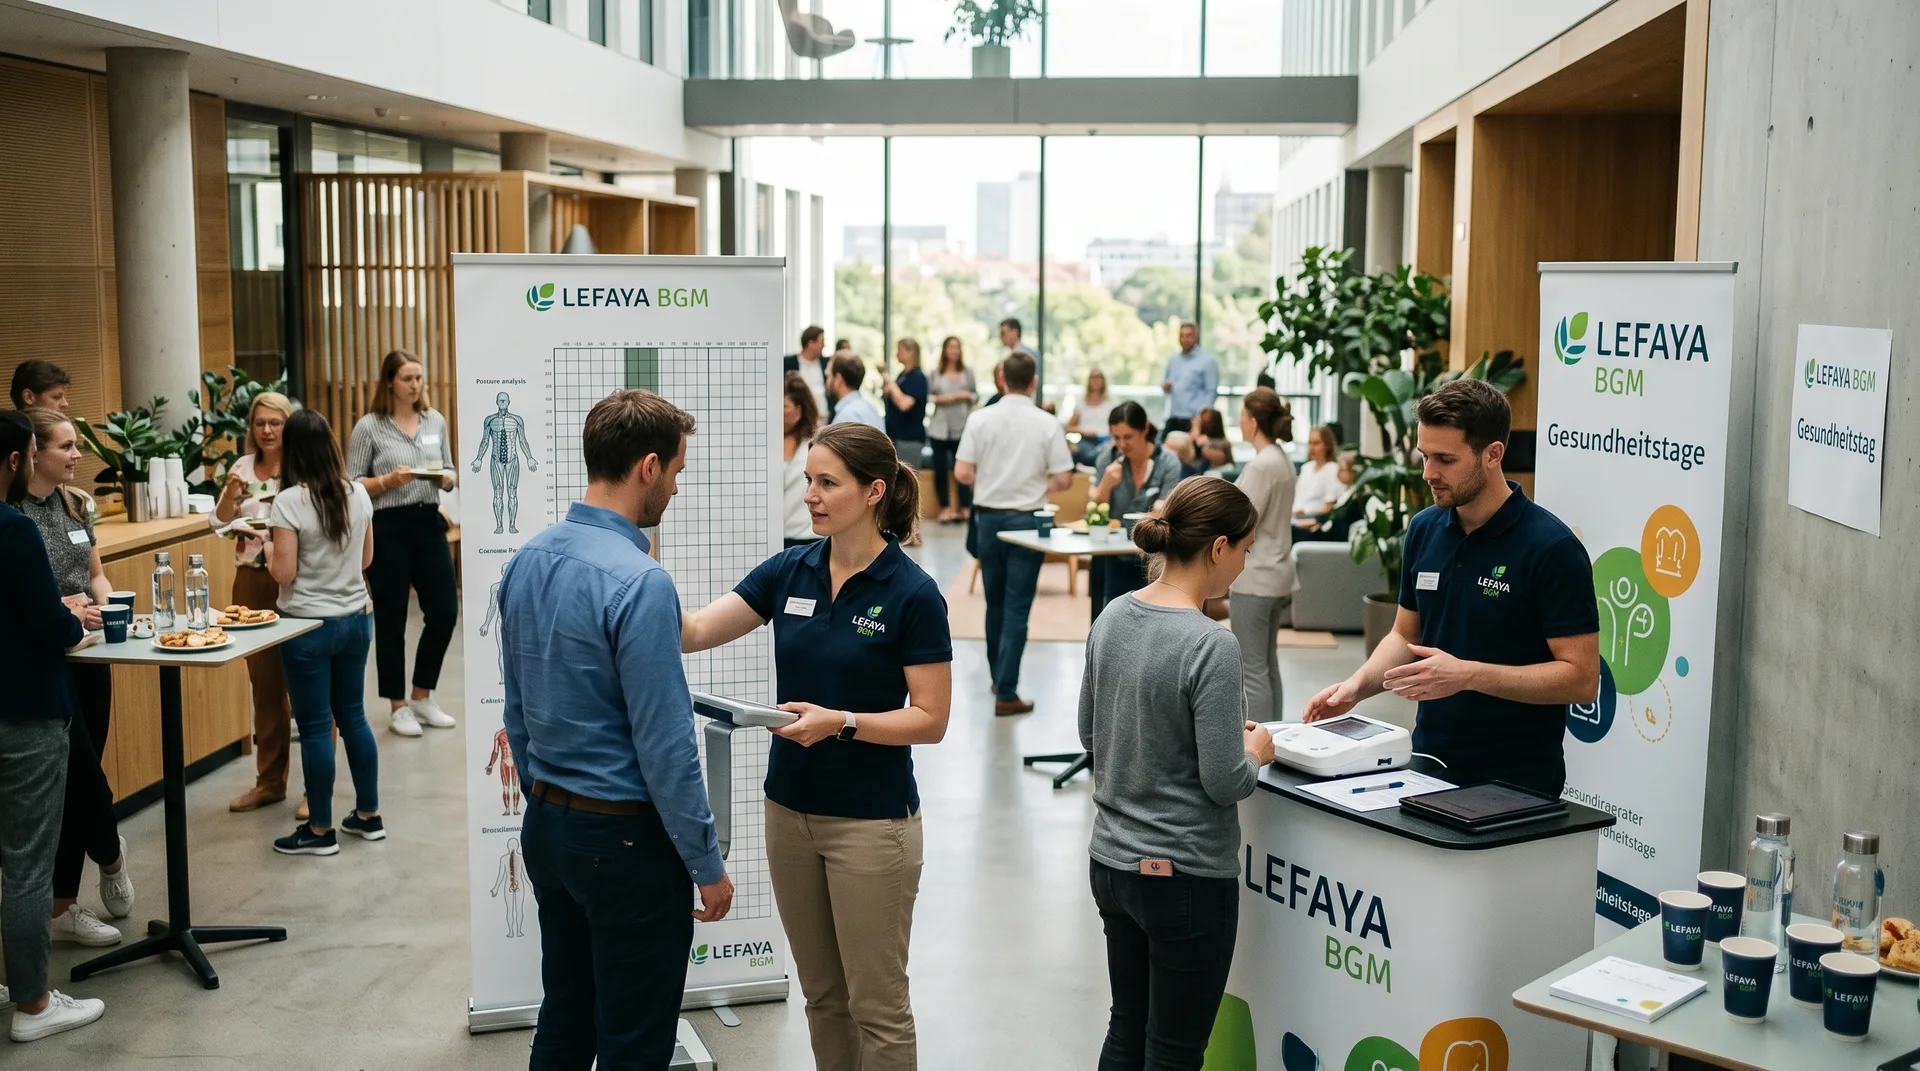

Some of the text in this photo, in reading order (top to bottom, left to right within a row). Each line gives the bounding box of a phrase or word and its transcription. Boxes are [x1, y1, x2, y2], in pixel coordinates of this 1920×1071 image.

[563, 288, 709, 307] LEFAYA BGM
[1597, 321, 1709, 362] LEFAYA
[502, 378, 526, 386] analysis
[1595, 366, 1644, 397] BGM
[1816, 364, 1876, 392] LEFAYA BGM
[1548, 422, 1706, 470] Gesundheitstage
[1798, 417, 1876, 463] Gesundheitstag
[1478, 576, 1510, 592] LEFAYA
[1482, 588, 1500, 598] BGM
[852, 615, 885, 632] LEFAYA
[1245, 844, 1392, 950] LEFAYA
[1670, 924, 1702, 934] LEFAYA
[713, 940, 773, 960] LEFAYA
[750, 956, 774, 968] BGM
[1325, 934, 1392, 993] BGM
[1725, 972, 1756, 986] LEFAYA
[1834, 992, 1869, 1004] LEFAYA
